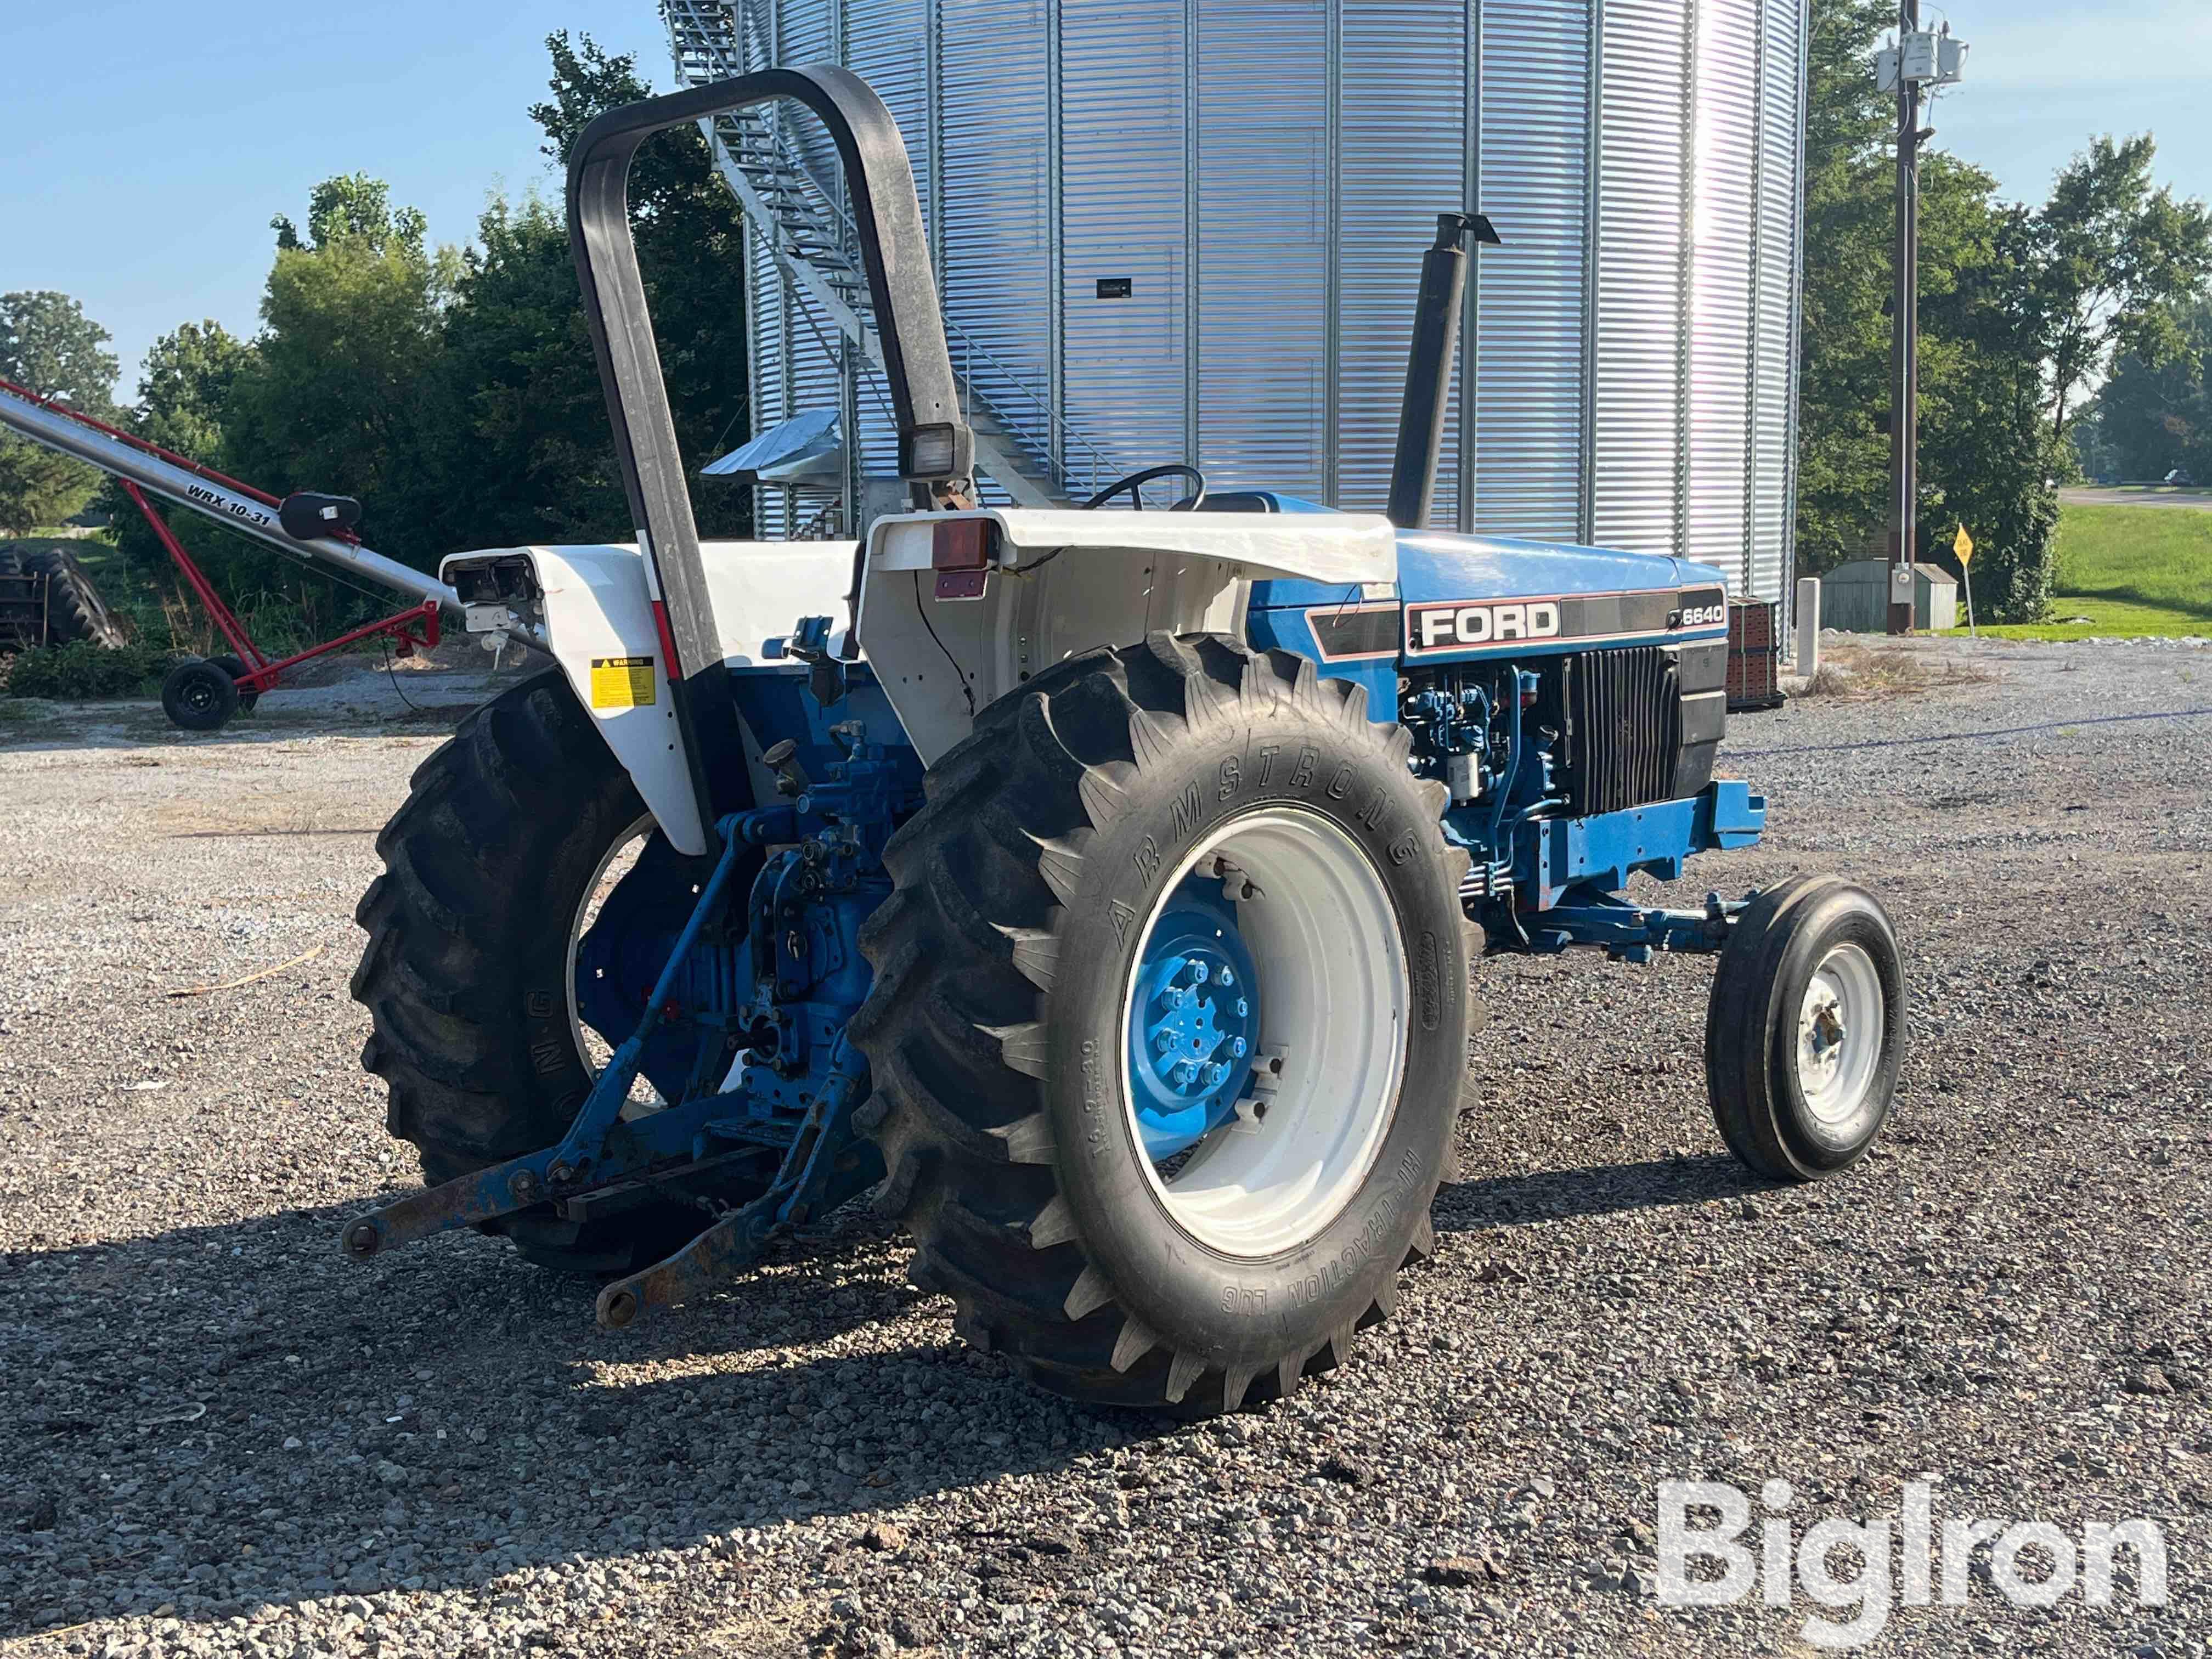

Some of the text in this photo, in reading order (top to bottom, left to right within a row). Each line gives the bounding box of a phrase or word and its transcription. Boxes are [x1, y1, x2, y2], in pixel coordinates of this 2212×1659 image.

[187, 484, 271, 526] WRX 10-31
[1421, 602, 1558, 647] FORD
[1683, 605, 1723, 625] 6640
[1108, 745, 1423, 952] ARMSTRONG
[1220, 1146, 1424, 1316] HI-TRACTION LUG
